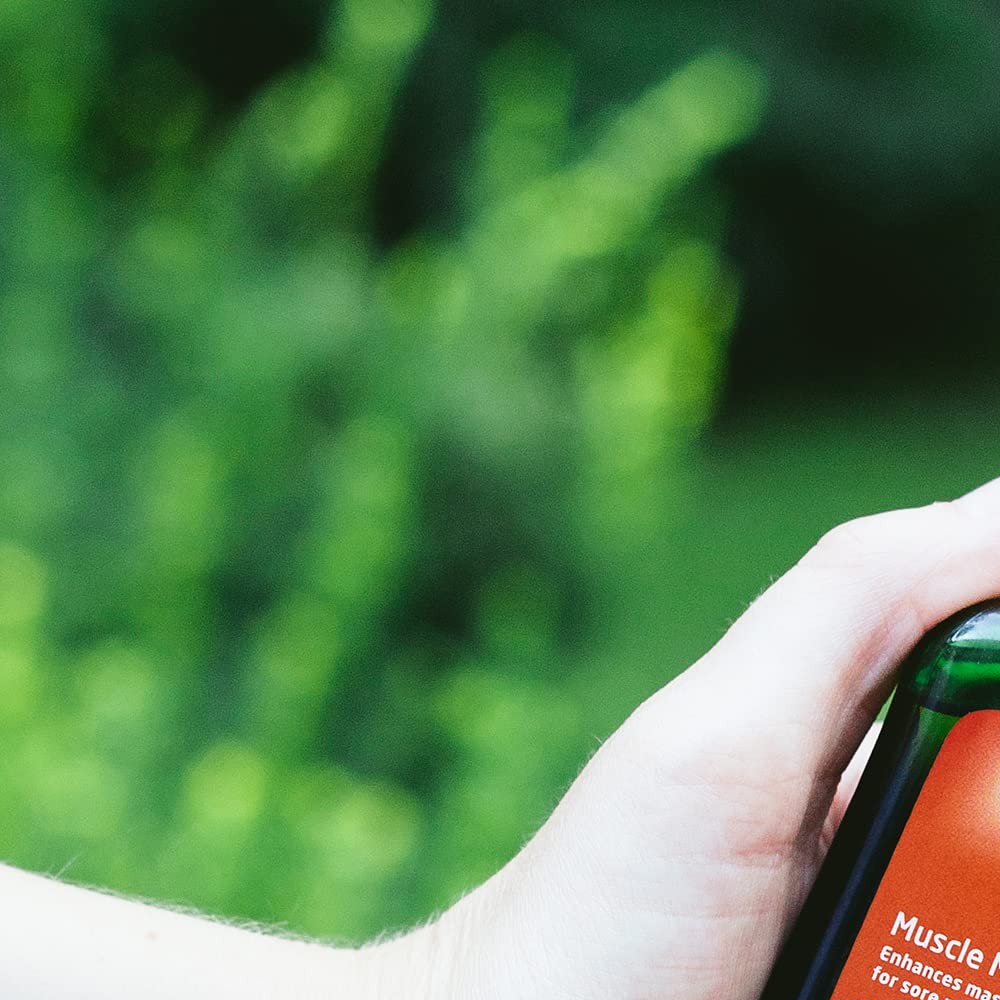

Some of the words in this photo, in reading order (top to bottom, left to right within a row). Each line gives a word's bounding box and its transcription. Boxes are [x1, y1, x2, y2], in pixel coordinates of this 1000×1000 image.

[890, 911, 984, 970] Muscle
[871, 965, 899, 988] for
[879, 945, 963, 991] Enhances
